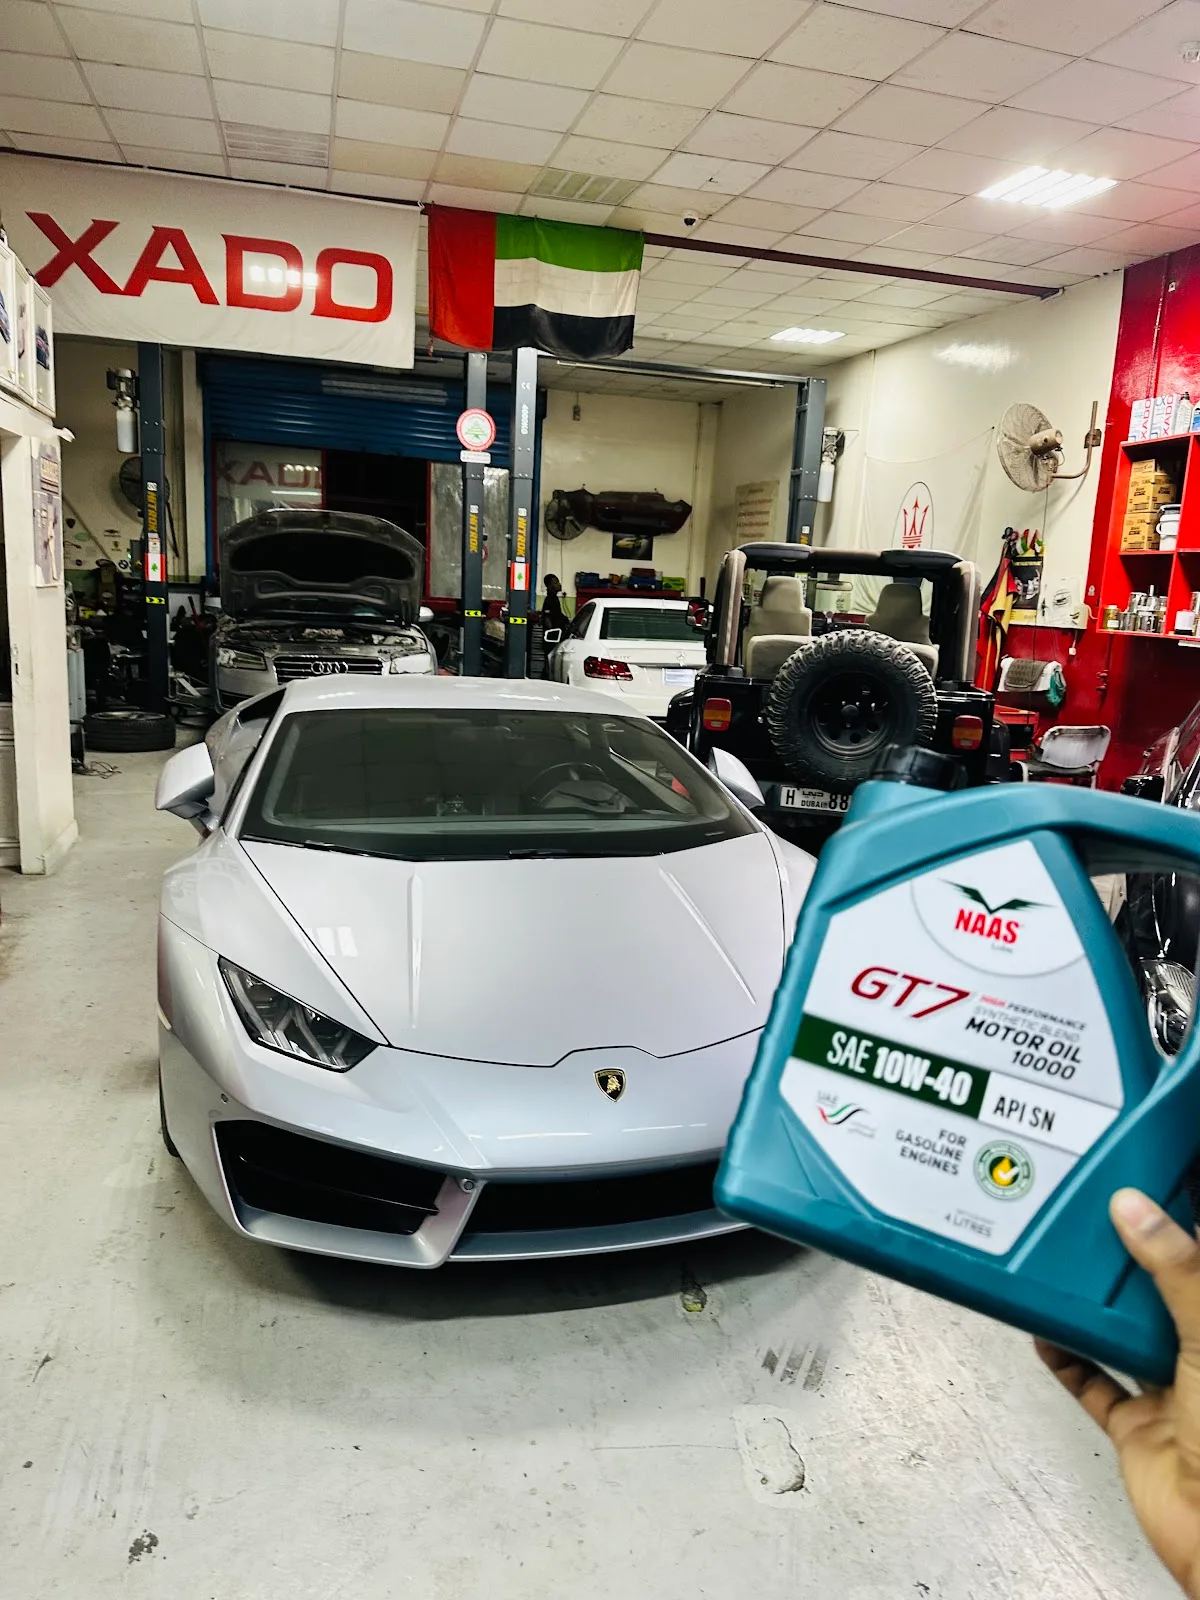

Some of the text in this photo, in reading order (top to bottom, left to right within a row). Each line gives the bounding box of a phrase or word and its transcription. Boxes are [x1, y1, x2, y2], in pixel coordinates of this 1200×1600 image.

[25, 211, 393, 323] XADO
[1141, 397, 1152, 440] XADO
[1163, 394, 1174, 436] XADO
[785, 789, 796, 805] H
[801, 800, 823, 808] DUBAI
[954, 908, 1020, 944] NAAS
[850, 965, 971, 1019] GT7
[974, 1005, 1081, 1043] SYNTHETIC BLEND
[1006, 1002, 1087, 1032] PERFORMANCE
[965, 1017, 1083, 1064] MOTOR OIL
[826, 1030, 973, 1106] SAE 10W-40
[1012, 1050, 1077, 1081] 10000
[992, 1096, 1056, 1132] API SN
[896, 1129, 963, 1162] GASOLINE
[938, 1129, 967, 1148] FOR
[900, 1146, 960, 1176] ENGINES
[952, 1213, 992, 1238] LITRES
